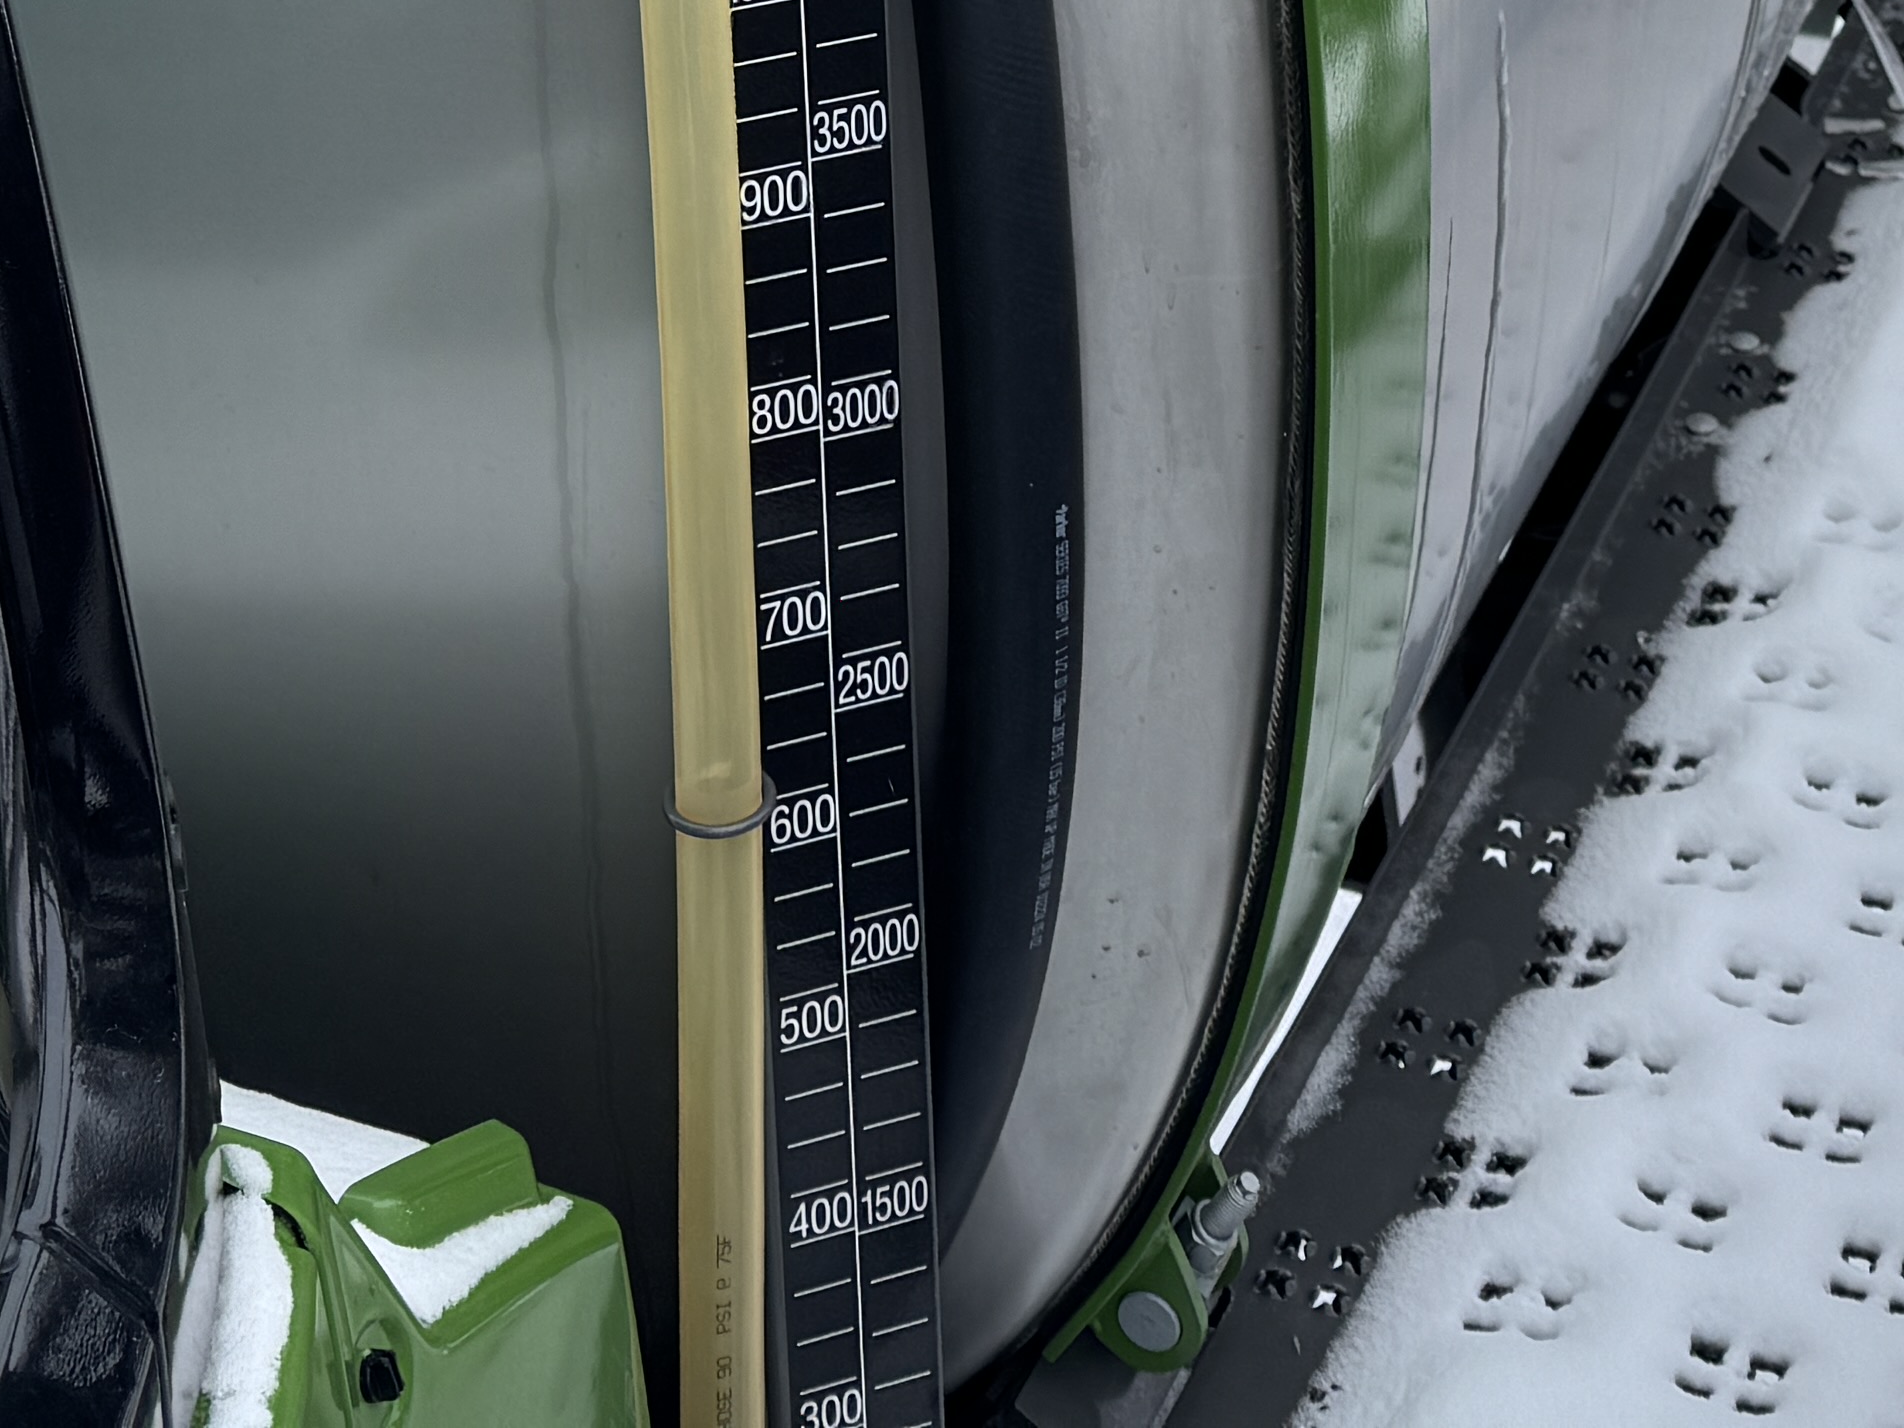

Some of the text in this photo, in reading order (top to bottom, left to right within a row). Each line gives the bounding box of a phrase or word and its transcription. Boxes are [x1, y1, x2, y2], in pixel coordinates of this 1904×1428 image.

[812, 99, 887, 154] 3500
[740, 169, 808, 222] 900
[752, 384, 817, 434] 800
[827, 379, 899, 430] 3000
[761, 590, 826, 642] 700
[838, 652, 909, 704] 2500
[770, 793, 836, 845] 600
[849, 912, 919, 966] 2000
[780, 994, 844, 1046] 500
[789, 1191, 853, 1239] 400
[862, 1174, 929, 1224] 1500
[716, 1301, 732, 1335] PSI
[716, 1356, 732, 1380] 90
[799, 1388, 862, 1428] 300
